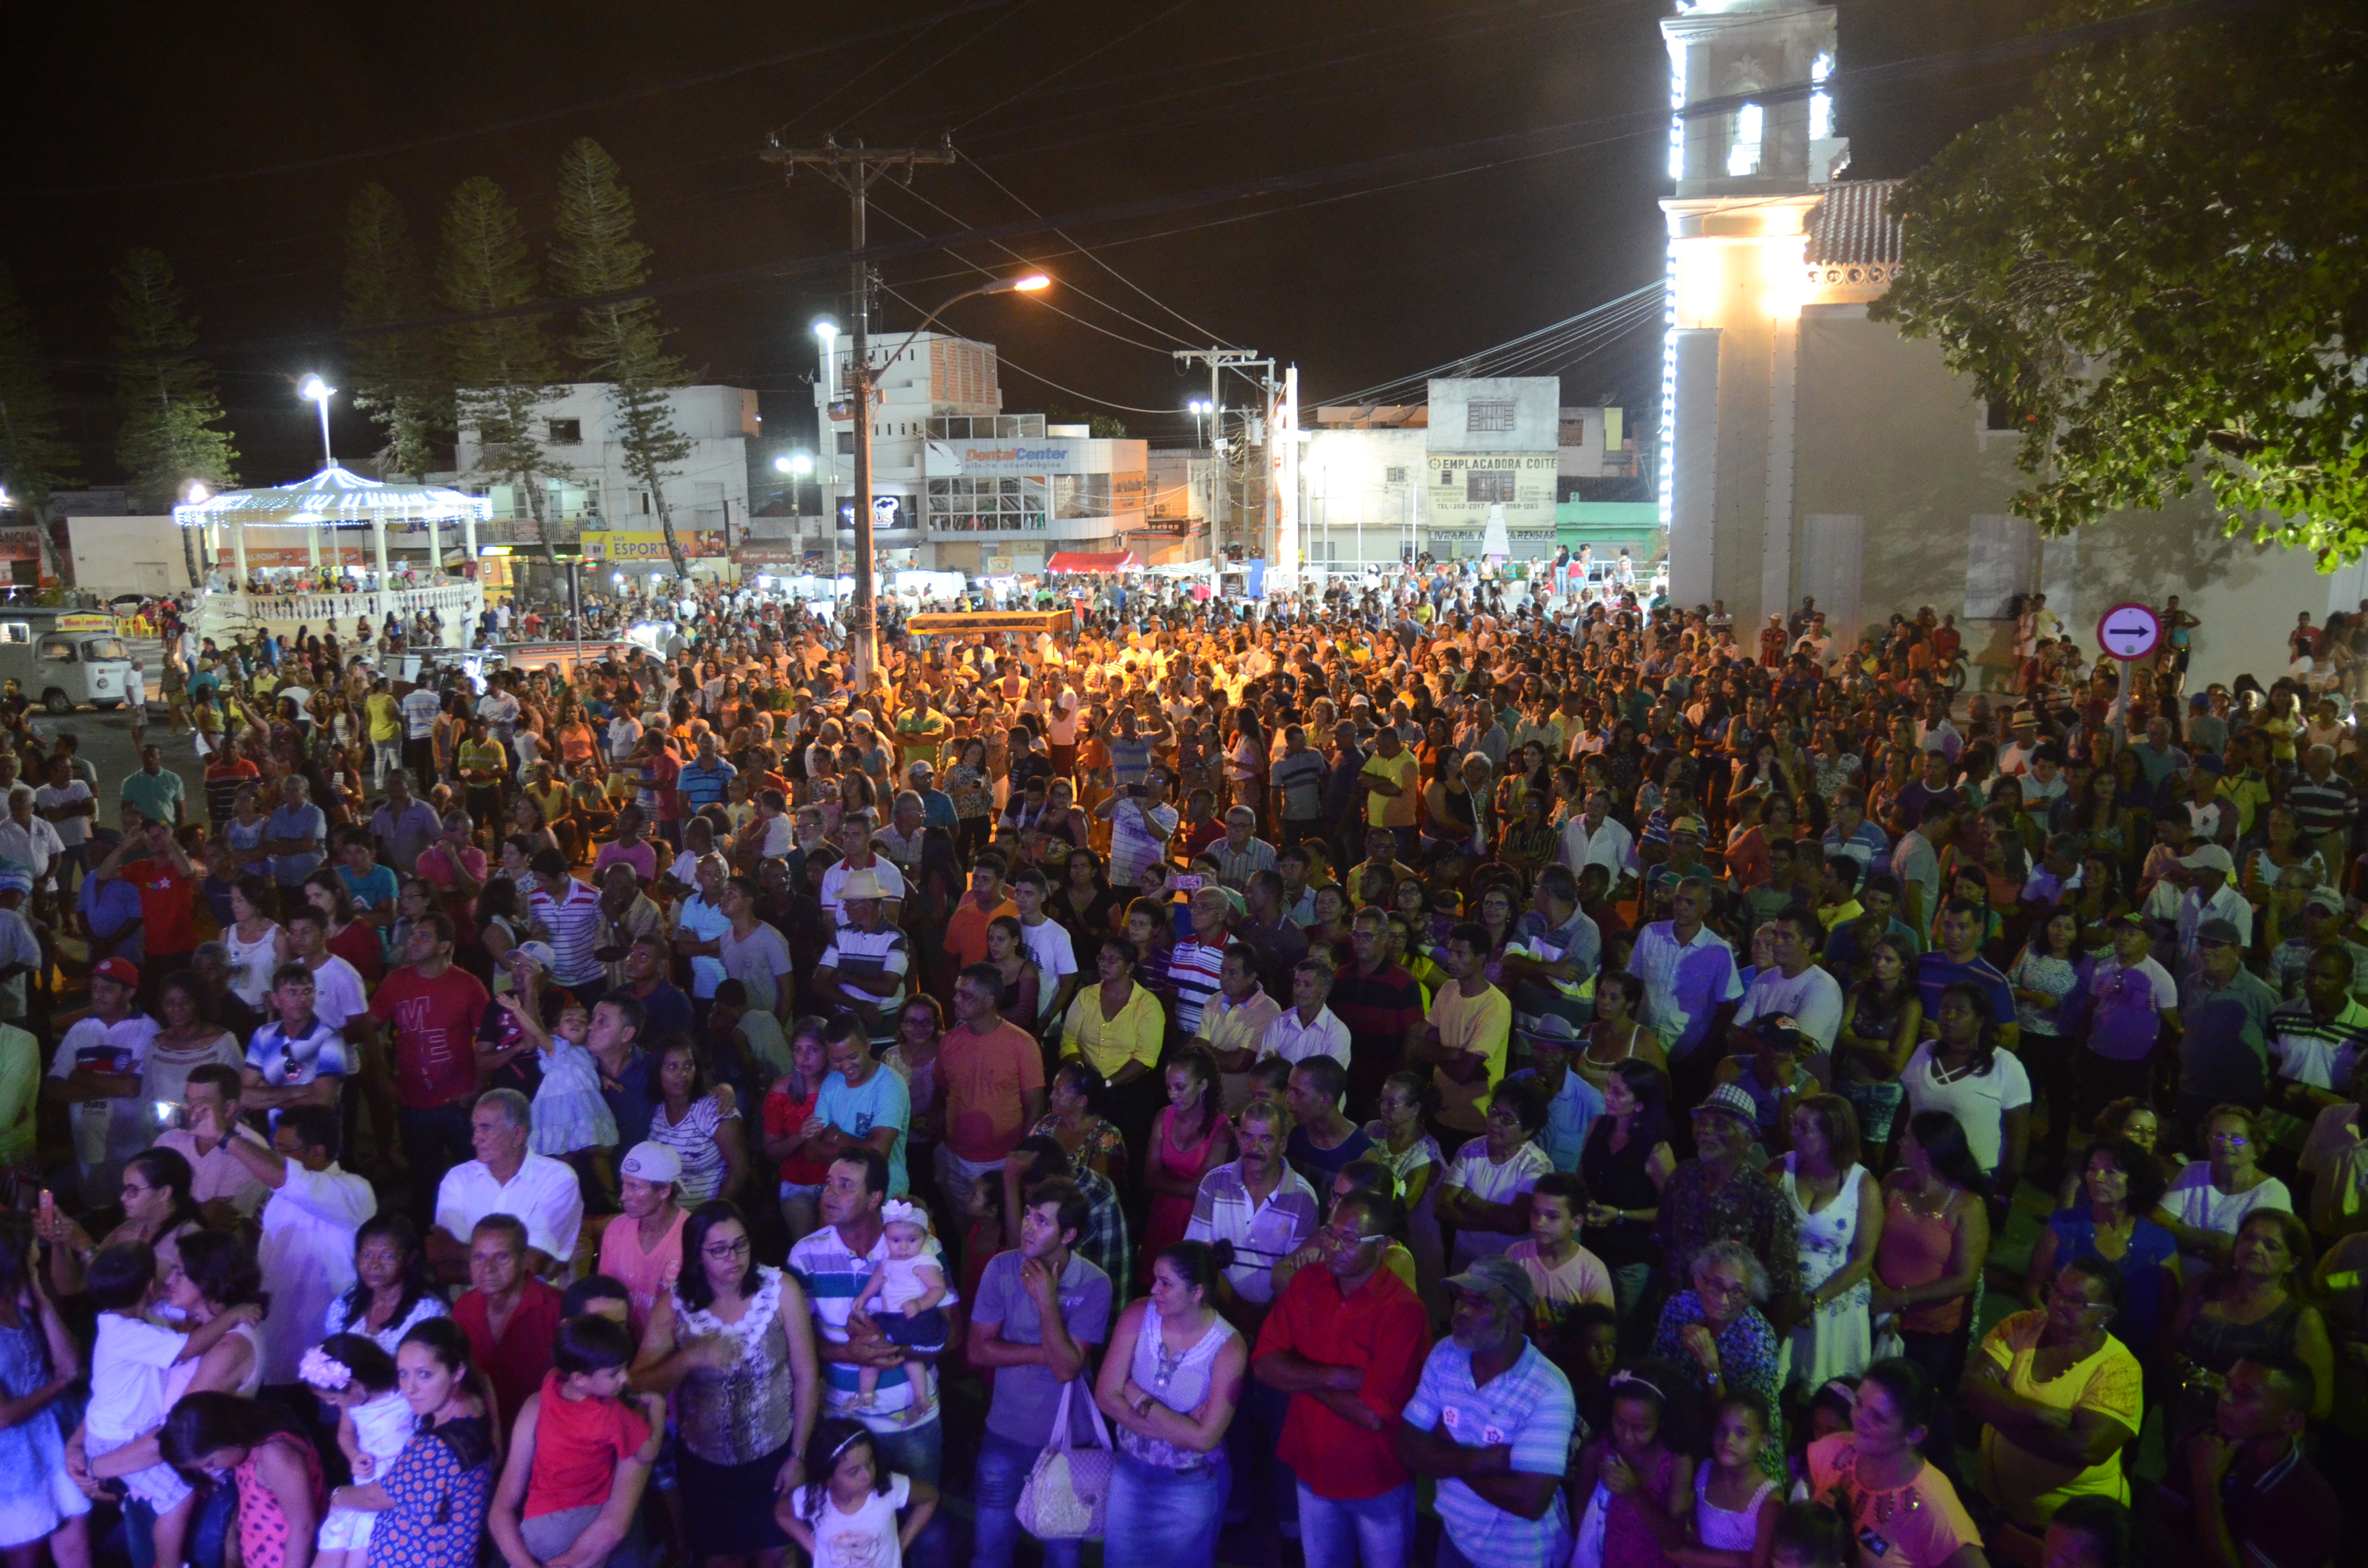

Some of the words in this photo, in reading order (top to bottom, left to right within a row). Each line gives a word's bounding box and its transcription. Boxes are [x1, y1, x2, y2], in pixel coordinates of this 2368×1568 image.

[966, 447, 1067, 461] DentalCenter
[1443, 459, 1521, 469] EMPLACADORA
[1527, 457, 1557, 469] COITÉ
[614, 543, 691, 555] ESPORTA
[256, 552, 280, 561] POINT
